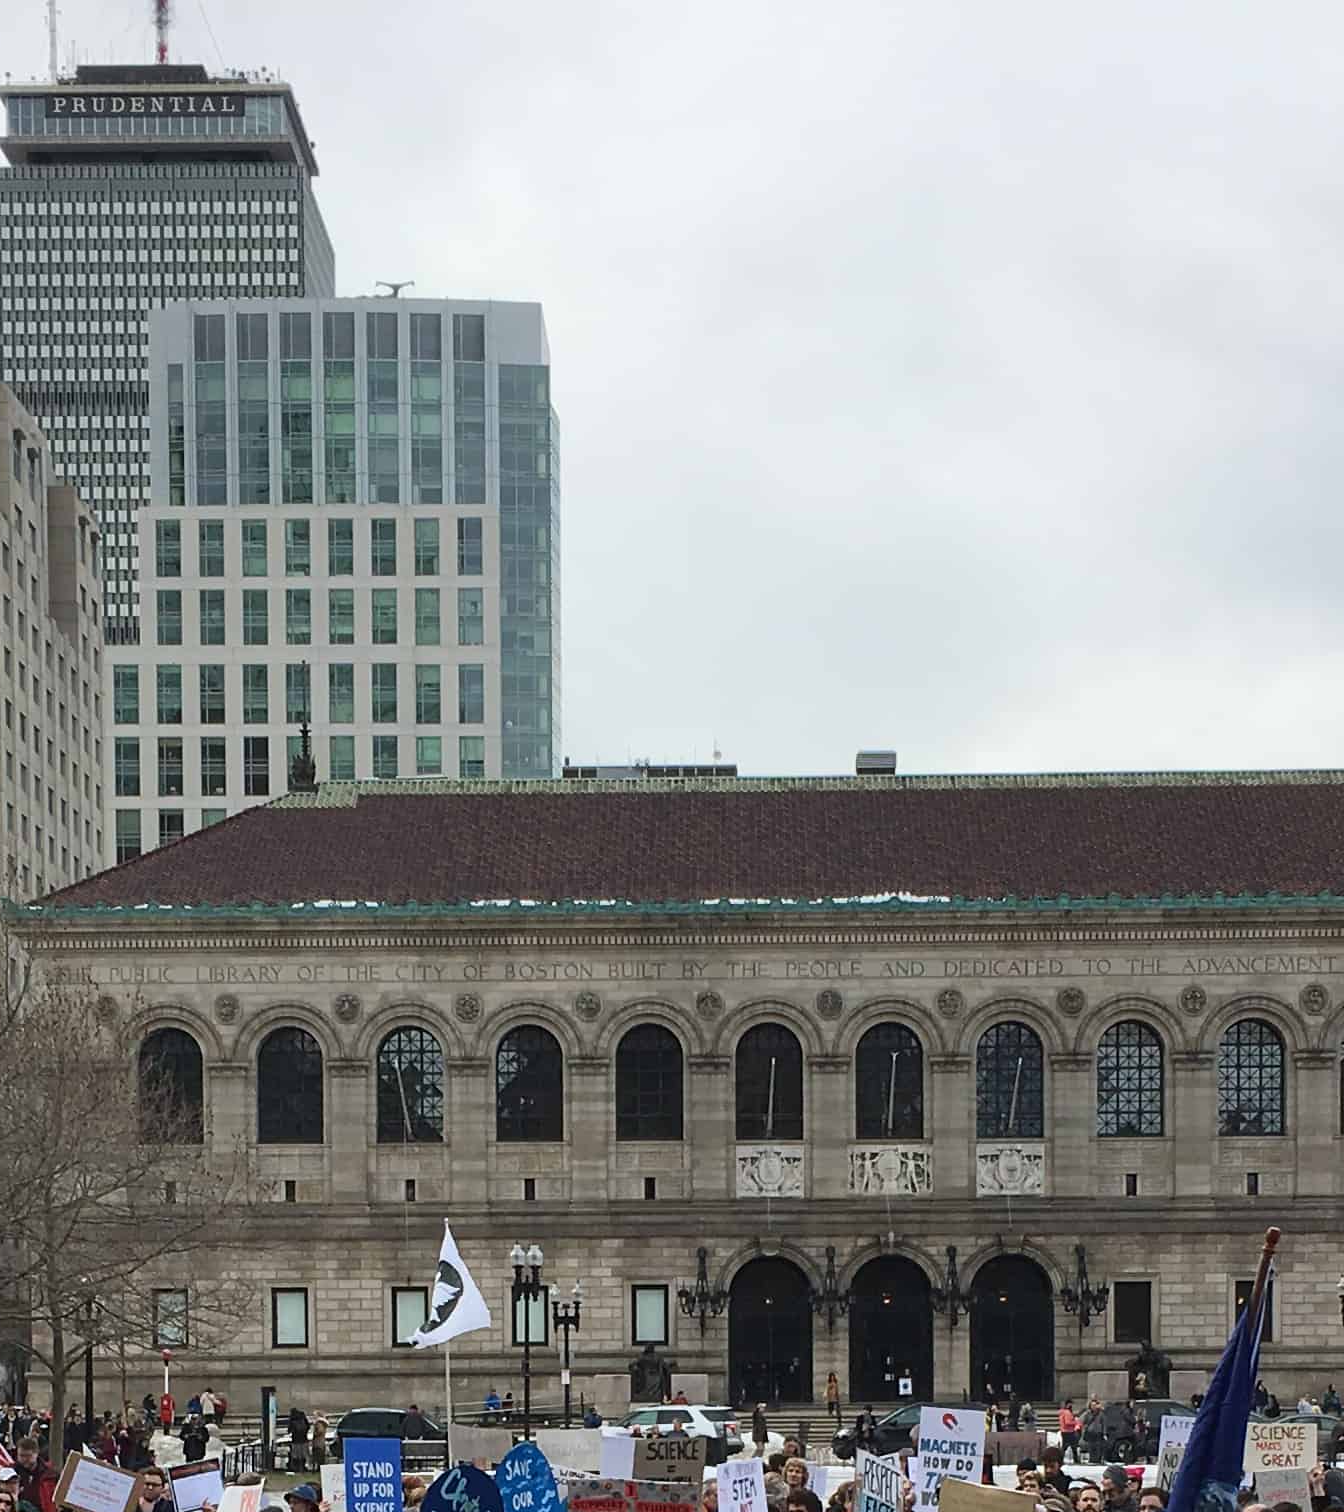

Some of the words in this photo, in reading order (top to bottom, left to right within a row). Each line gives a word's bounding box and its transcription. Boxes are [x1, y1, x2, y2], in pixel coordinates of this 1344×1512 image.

[53, 97, 236, 113] PRUDENTIAL
[109, 967, 173, 983] PUBLIC
[196, 966, 283, 983] LIBRARY
[297, 966, 325, 982] OF
[345, 966, 382, 982] THE
[395, 965, 447, 981] CITY
[463, 964, 491, 980] OF
[505, 963, 594, 980] BOSTON
[608, 962, 667, 978] BUILT
[681, 962, 709, 978] BY
[725, 961, 769, 977] THE
[785, 961, 863, 977] PEOPLE
[879, 960, 925, 977] AND
[944, 959, 1064, 976] DEDICATED
[1082, 959, 1112, 976] TO
[1183, 956, 1337, 974] ADVANCEMENT
[1251, 1424, 1306, 1441] SCIENCE
[646, 1438, 700, 1461] SCIENCE
[920, 1437, 977, 1457] MAGNETS
[1287, 1441, 1304, 1451] US
[923, 1456, 951, 1470] HOW
[956, 1459, 974, 1472] DO
[1262, 1453, 1302, 1467] GREAT
[353, 1461, 395, 1478] STAND
[506, 1458, 533, 1481] SAVE
[353, 1482, 370, 1498] UP
[372, 1482, 395, 1498] FOR
[732, 1477, 758, 1501] STEM
[863, 1457, 901, 1506] RESPECT
[512, 1491, 535, 1511] OUR
[572, 1501, 625, 1512] SUPPORT
